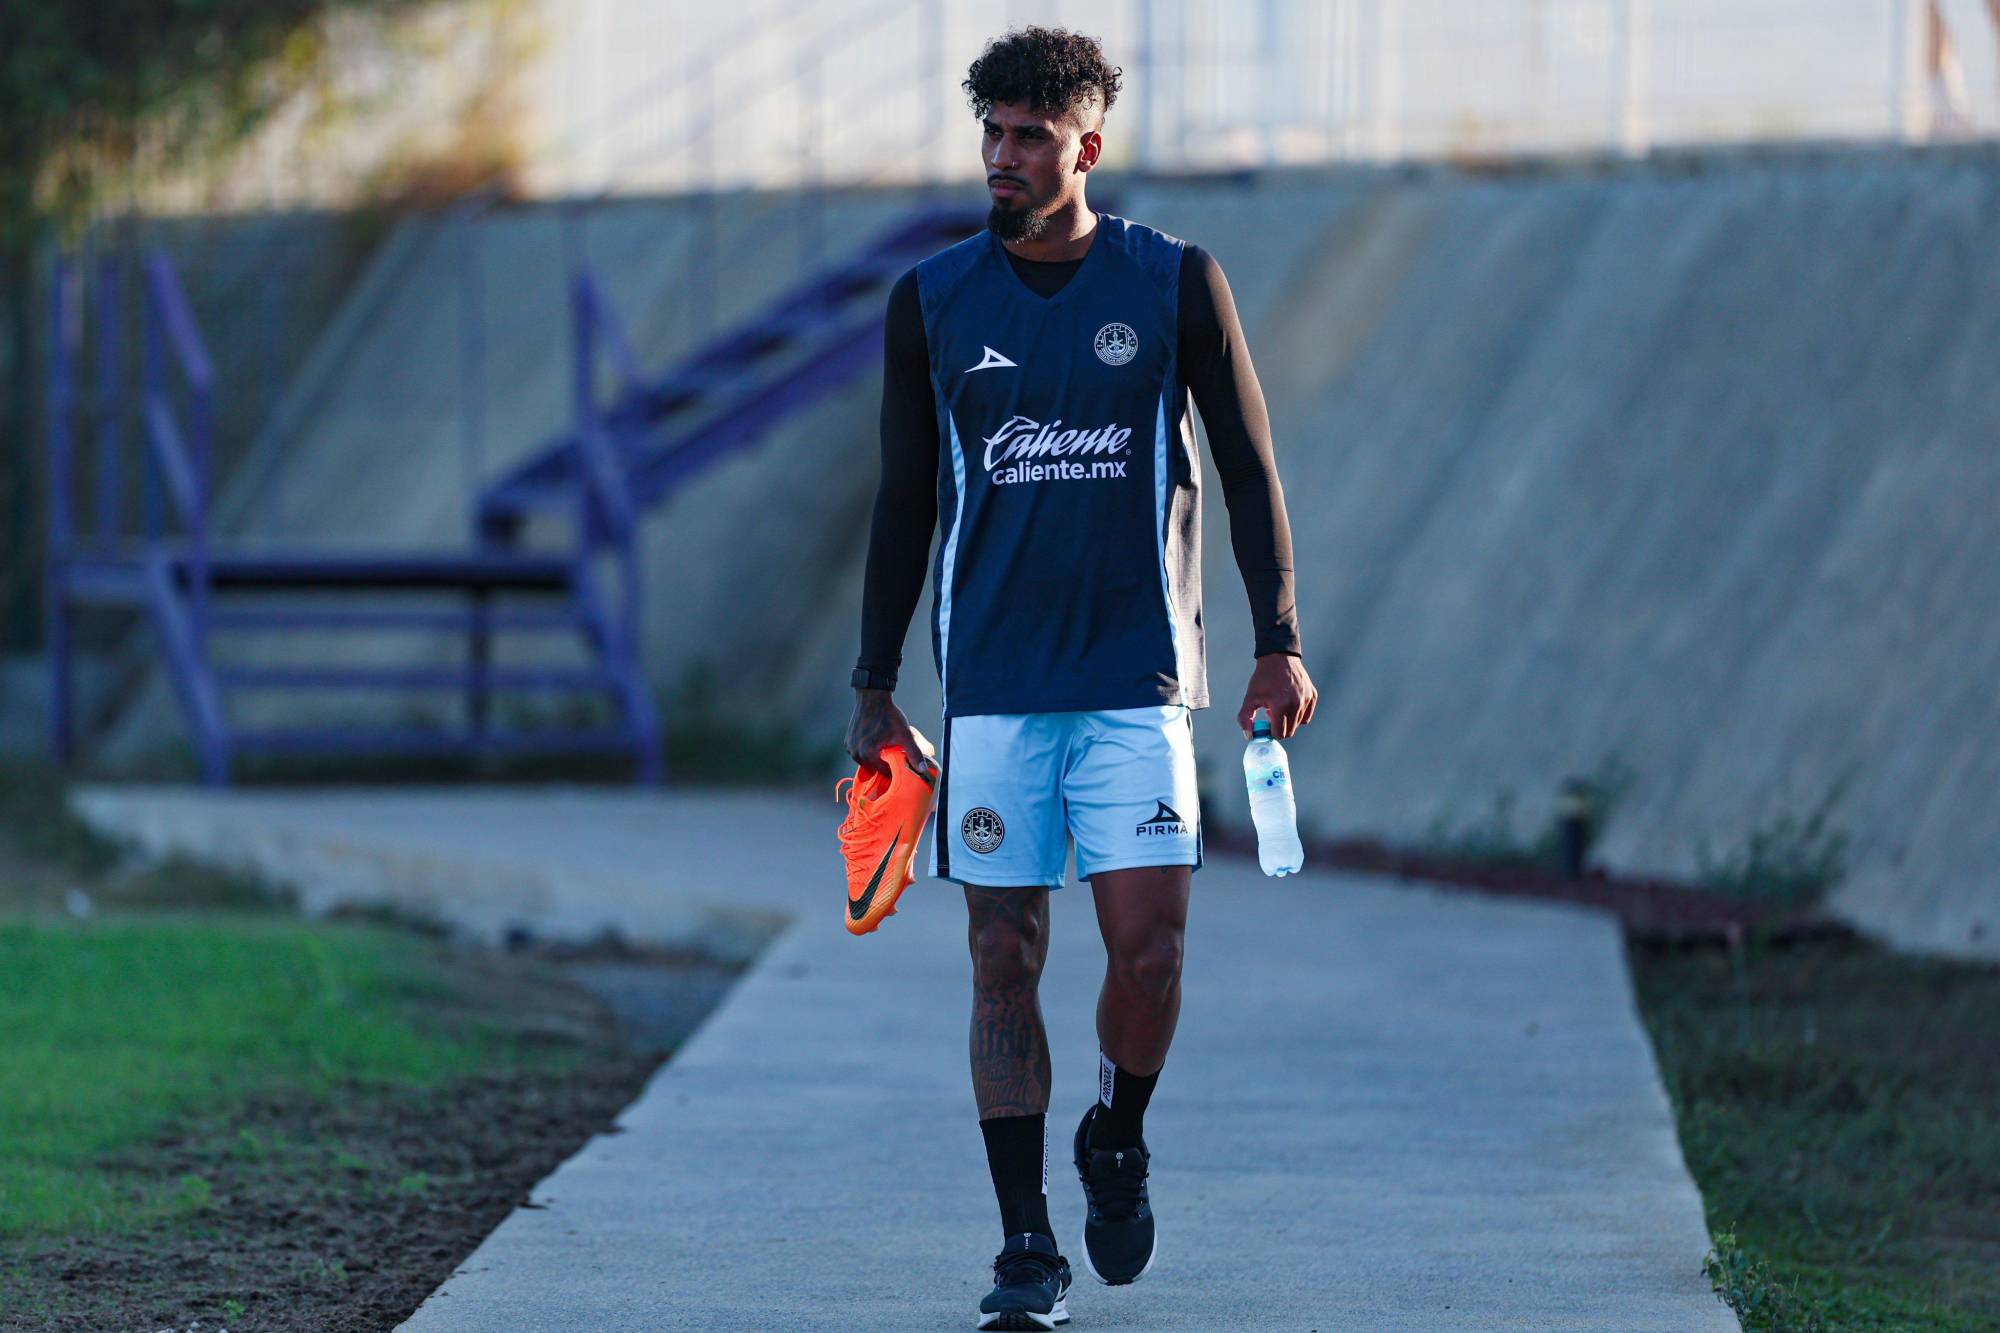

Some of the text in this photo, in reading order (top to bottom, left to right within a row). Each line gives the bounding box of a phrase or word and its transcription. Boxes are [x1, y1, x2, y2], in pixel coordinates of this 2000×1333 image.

[982, 415, 1132, 471] Caliente
[992, 460, 1127, 485] caliente.mx
[1136, 824, 1188, 836] PIRMA
